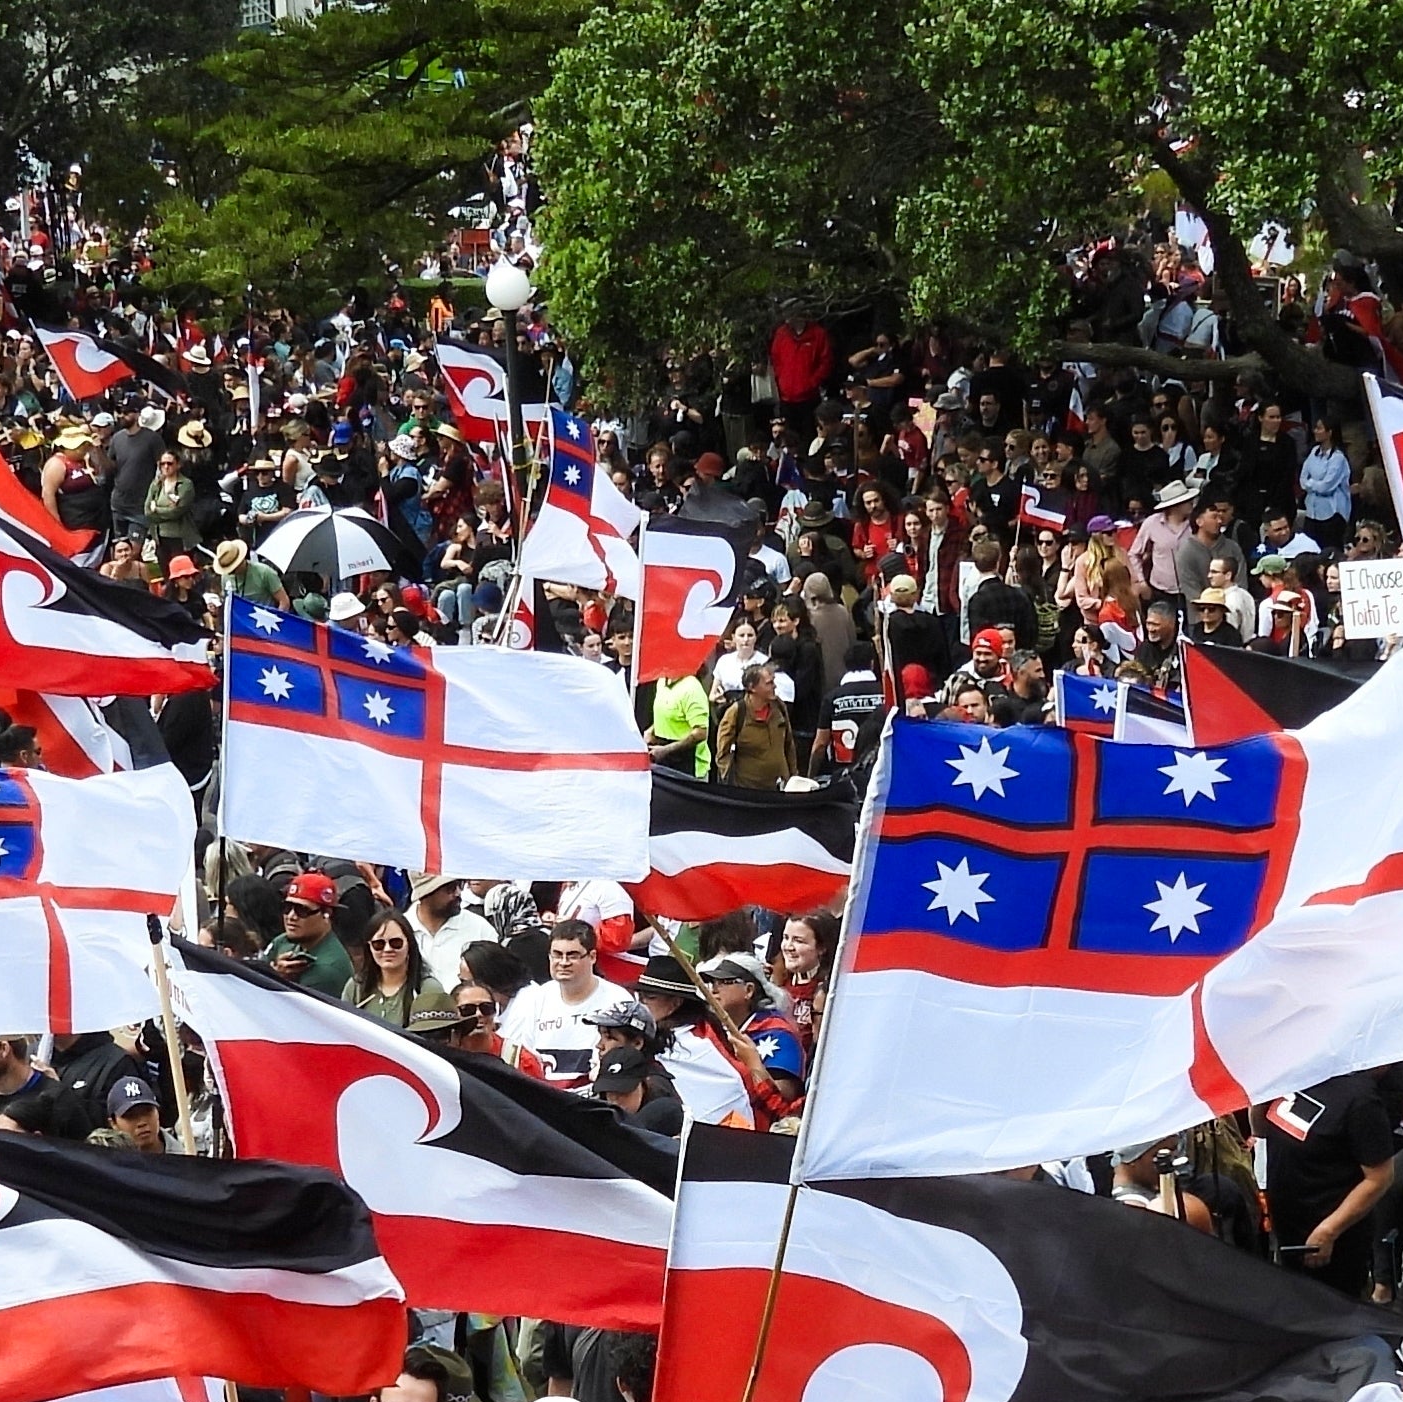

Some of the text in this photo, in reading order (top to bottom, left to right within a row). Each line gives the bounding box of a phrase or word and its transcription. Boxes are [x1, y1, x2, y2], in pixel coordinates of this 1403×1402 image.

[1345, 569, 1355, 590] I
[1359, 568, 1403, 590] Choose
[1382, 594, 1400, 625] Te
